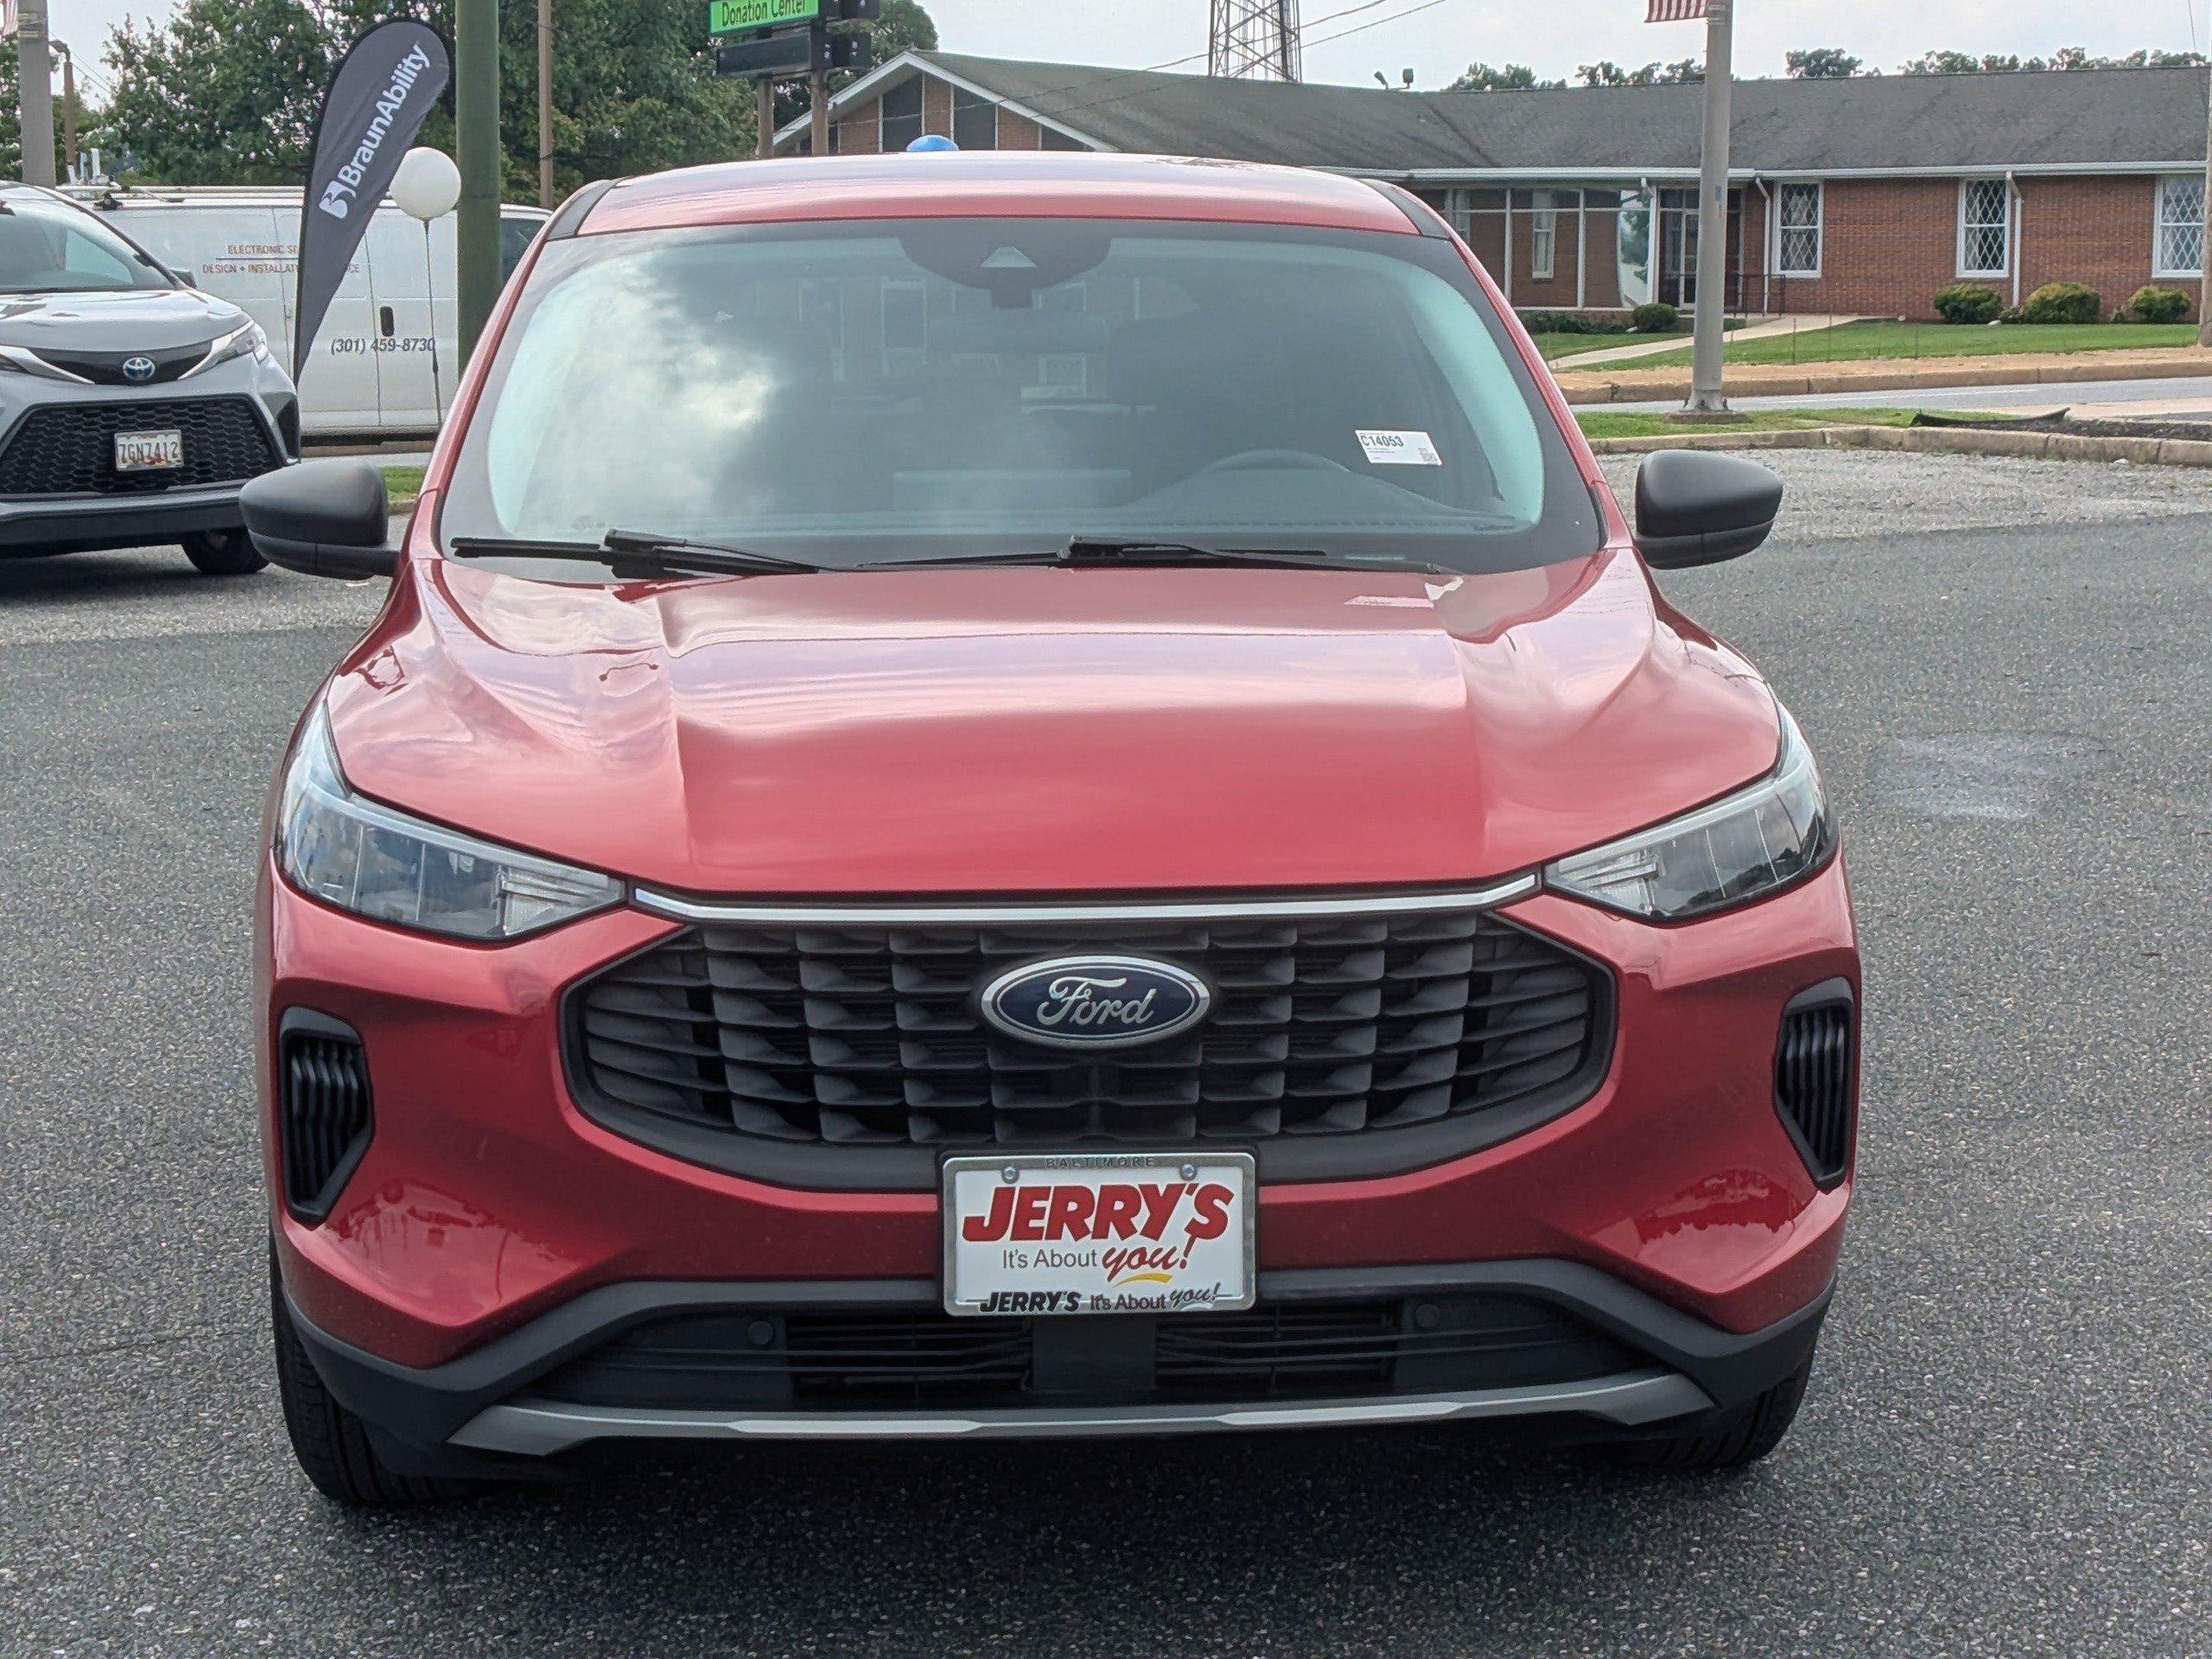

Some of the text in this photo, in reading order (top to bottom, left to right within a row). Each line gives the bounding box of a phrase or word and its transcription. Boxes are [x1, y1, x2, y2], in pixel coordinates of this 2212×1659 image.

[721, 0, 806, 27] Donation Center
[338, 43, 430, 187] BraunAbility
[228, 245, 284, 254] ELECTRONIC
[202, 264, 238, 274] DESIGN
[331, 337, 436, 356] (301) 459-8730
[1360, 435, 1404, 448] C14053
[1037, 976, 1157, 1026] Ford
[1045, 1155, 1155, 1168] BALTIMORE
[962, 1183, 1235, 1243] JERRY'S
[1002, 1236, 1196, 1283] It's About you!
[980, 1282, 1222, 1313] JERRY'S It's About you!
